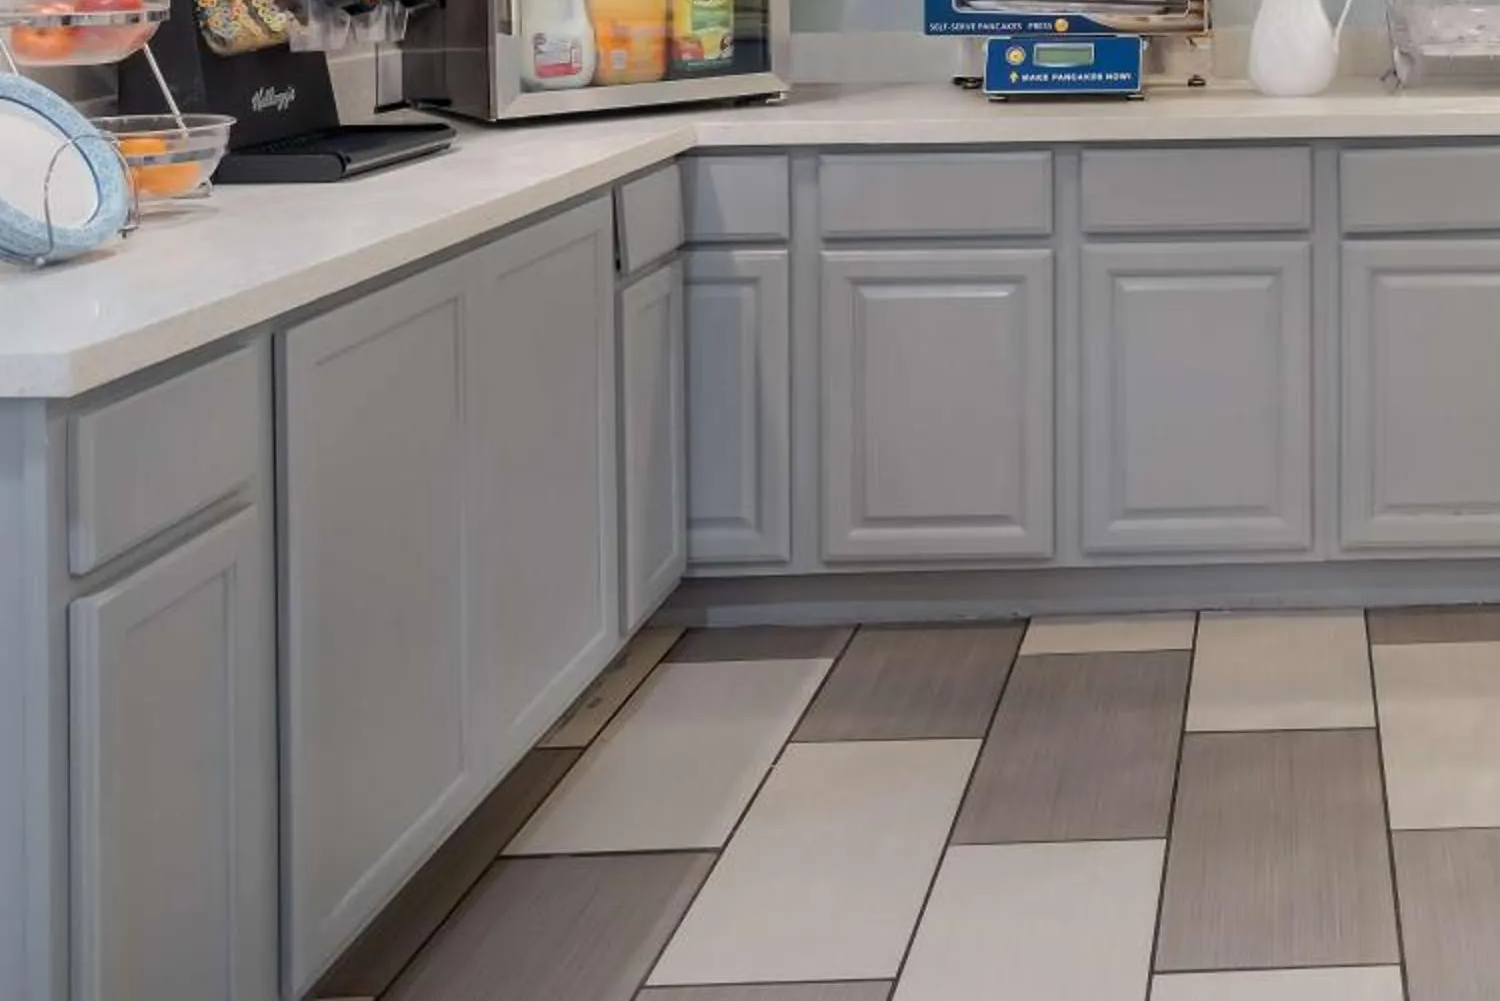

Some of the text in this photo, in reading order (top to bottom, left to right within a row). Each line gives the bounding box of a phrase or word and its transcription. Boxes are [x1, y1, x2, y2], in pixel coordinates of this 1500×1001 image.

[977, 21, 1022, 31] PANCAKES
[1021, 72, 1048, 82] MAKE
[1052, 72, 1103, 82] PANCAKES
[251, 86, 295, 111] Kellogg's
